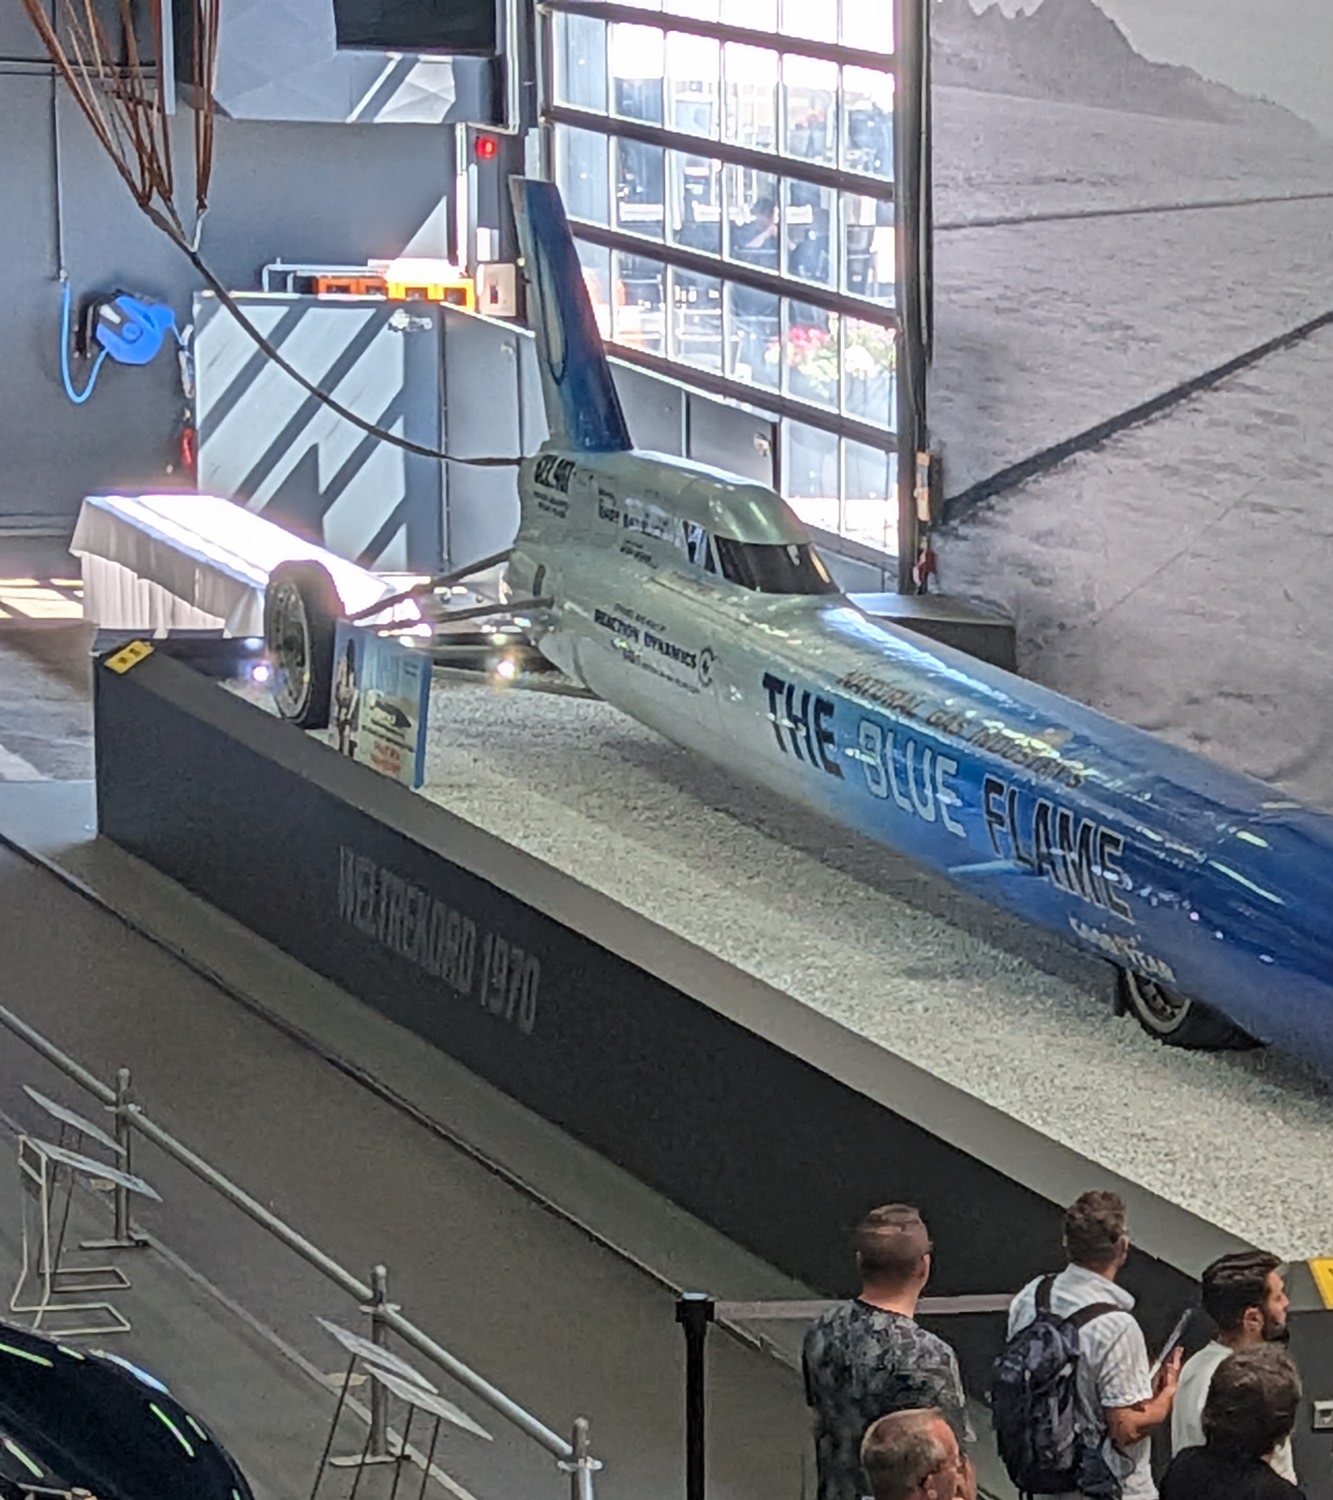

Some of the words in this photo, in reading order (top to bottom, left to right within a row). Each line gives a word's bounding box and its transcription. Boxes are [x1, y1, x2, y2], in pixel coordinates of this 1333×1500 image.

[837, 670, 921, 718] NATURAL
[762, 672, 845, 780] THE
[857, 718, 967, 838] BLUE
[982, 772, 1135, 925] FLAME
[481, 932, 540, 1035] 1970
